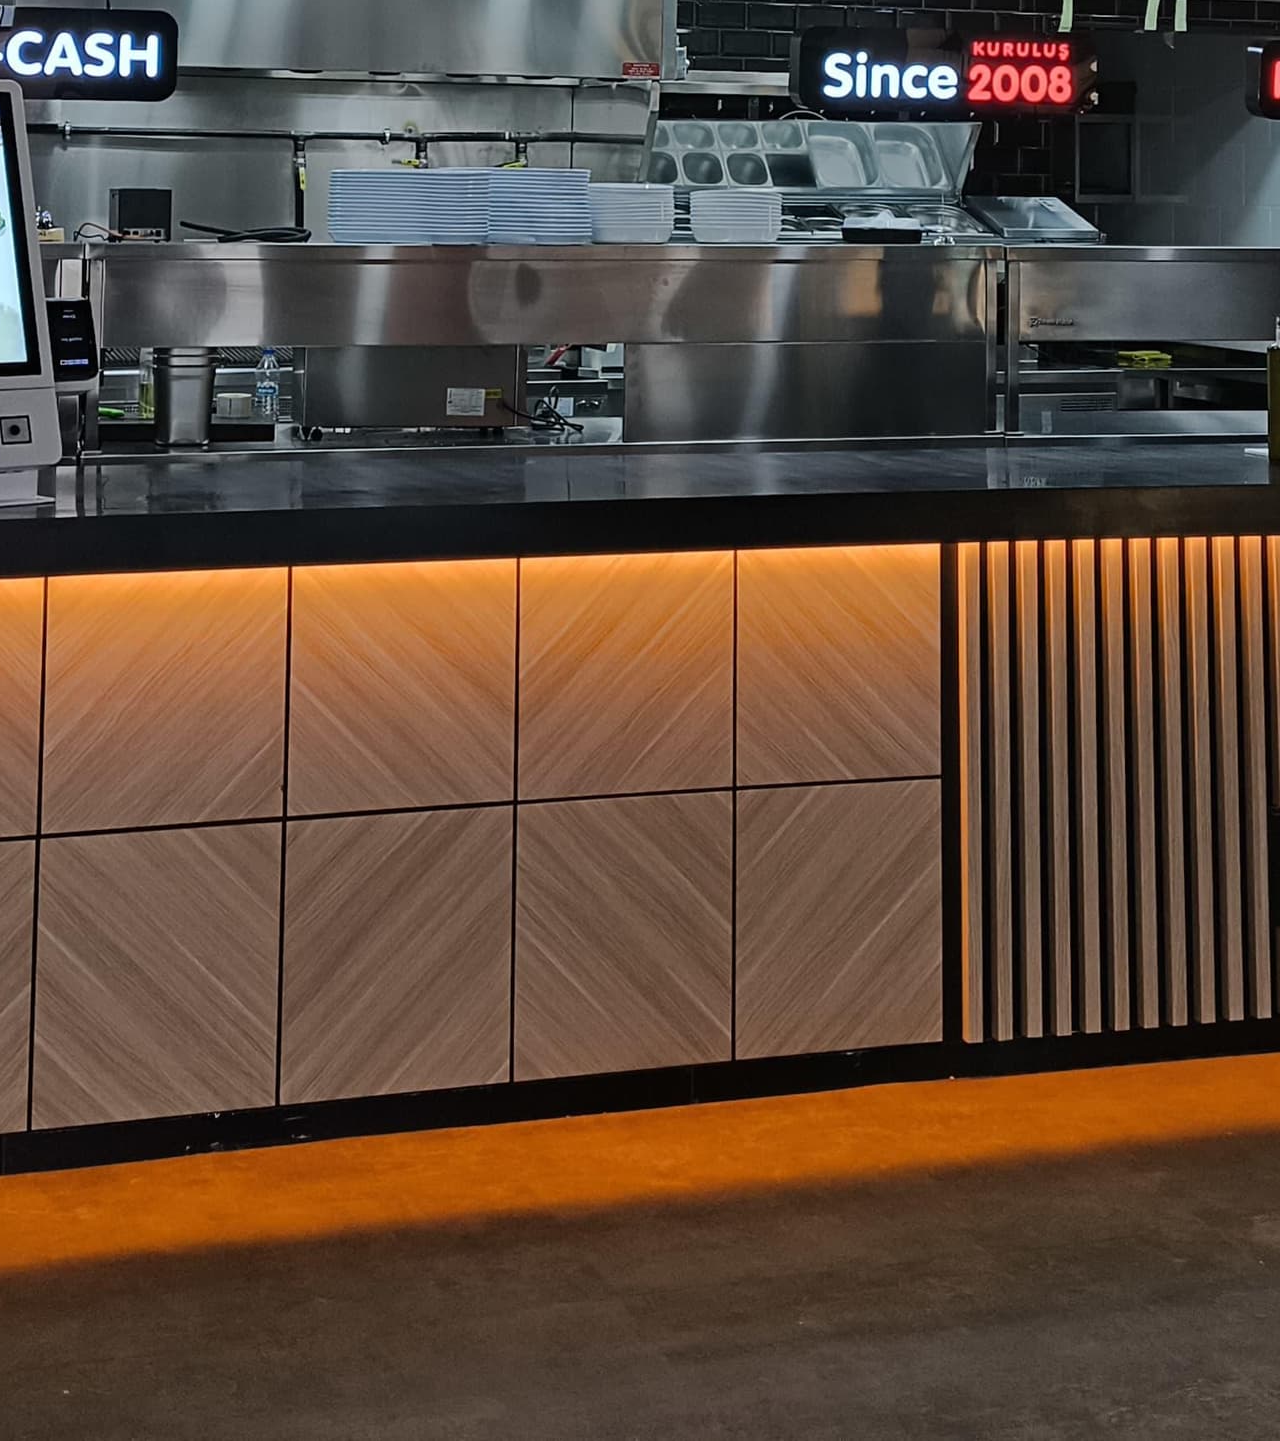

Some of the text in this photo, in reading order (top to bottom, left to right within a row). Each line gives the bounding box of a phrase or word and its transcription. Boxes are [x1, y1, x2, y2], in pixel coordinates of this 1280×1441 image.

[971, 40, 1071, 61] KURULUŞ
[822, 50, 1073, 103] Since 2008
